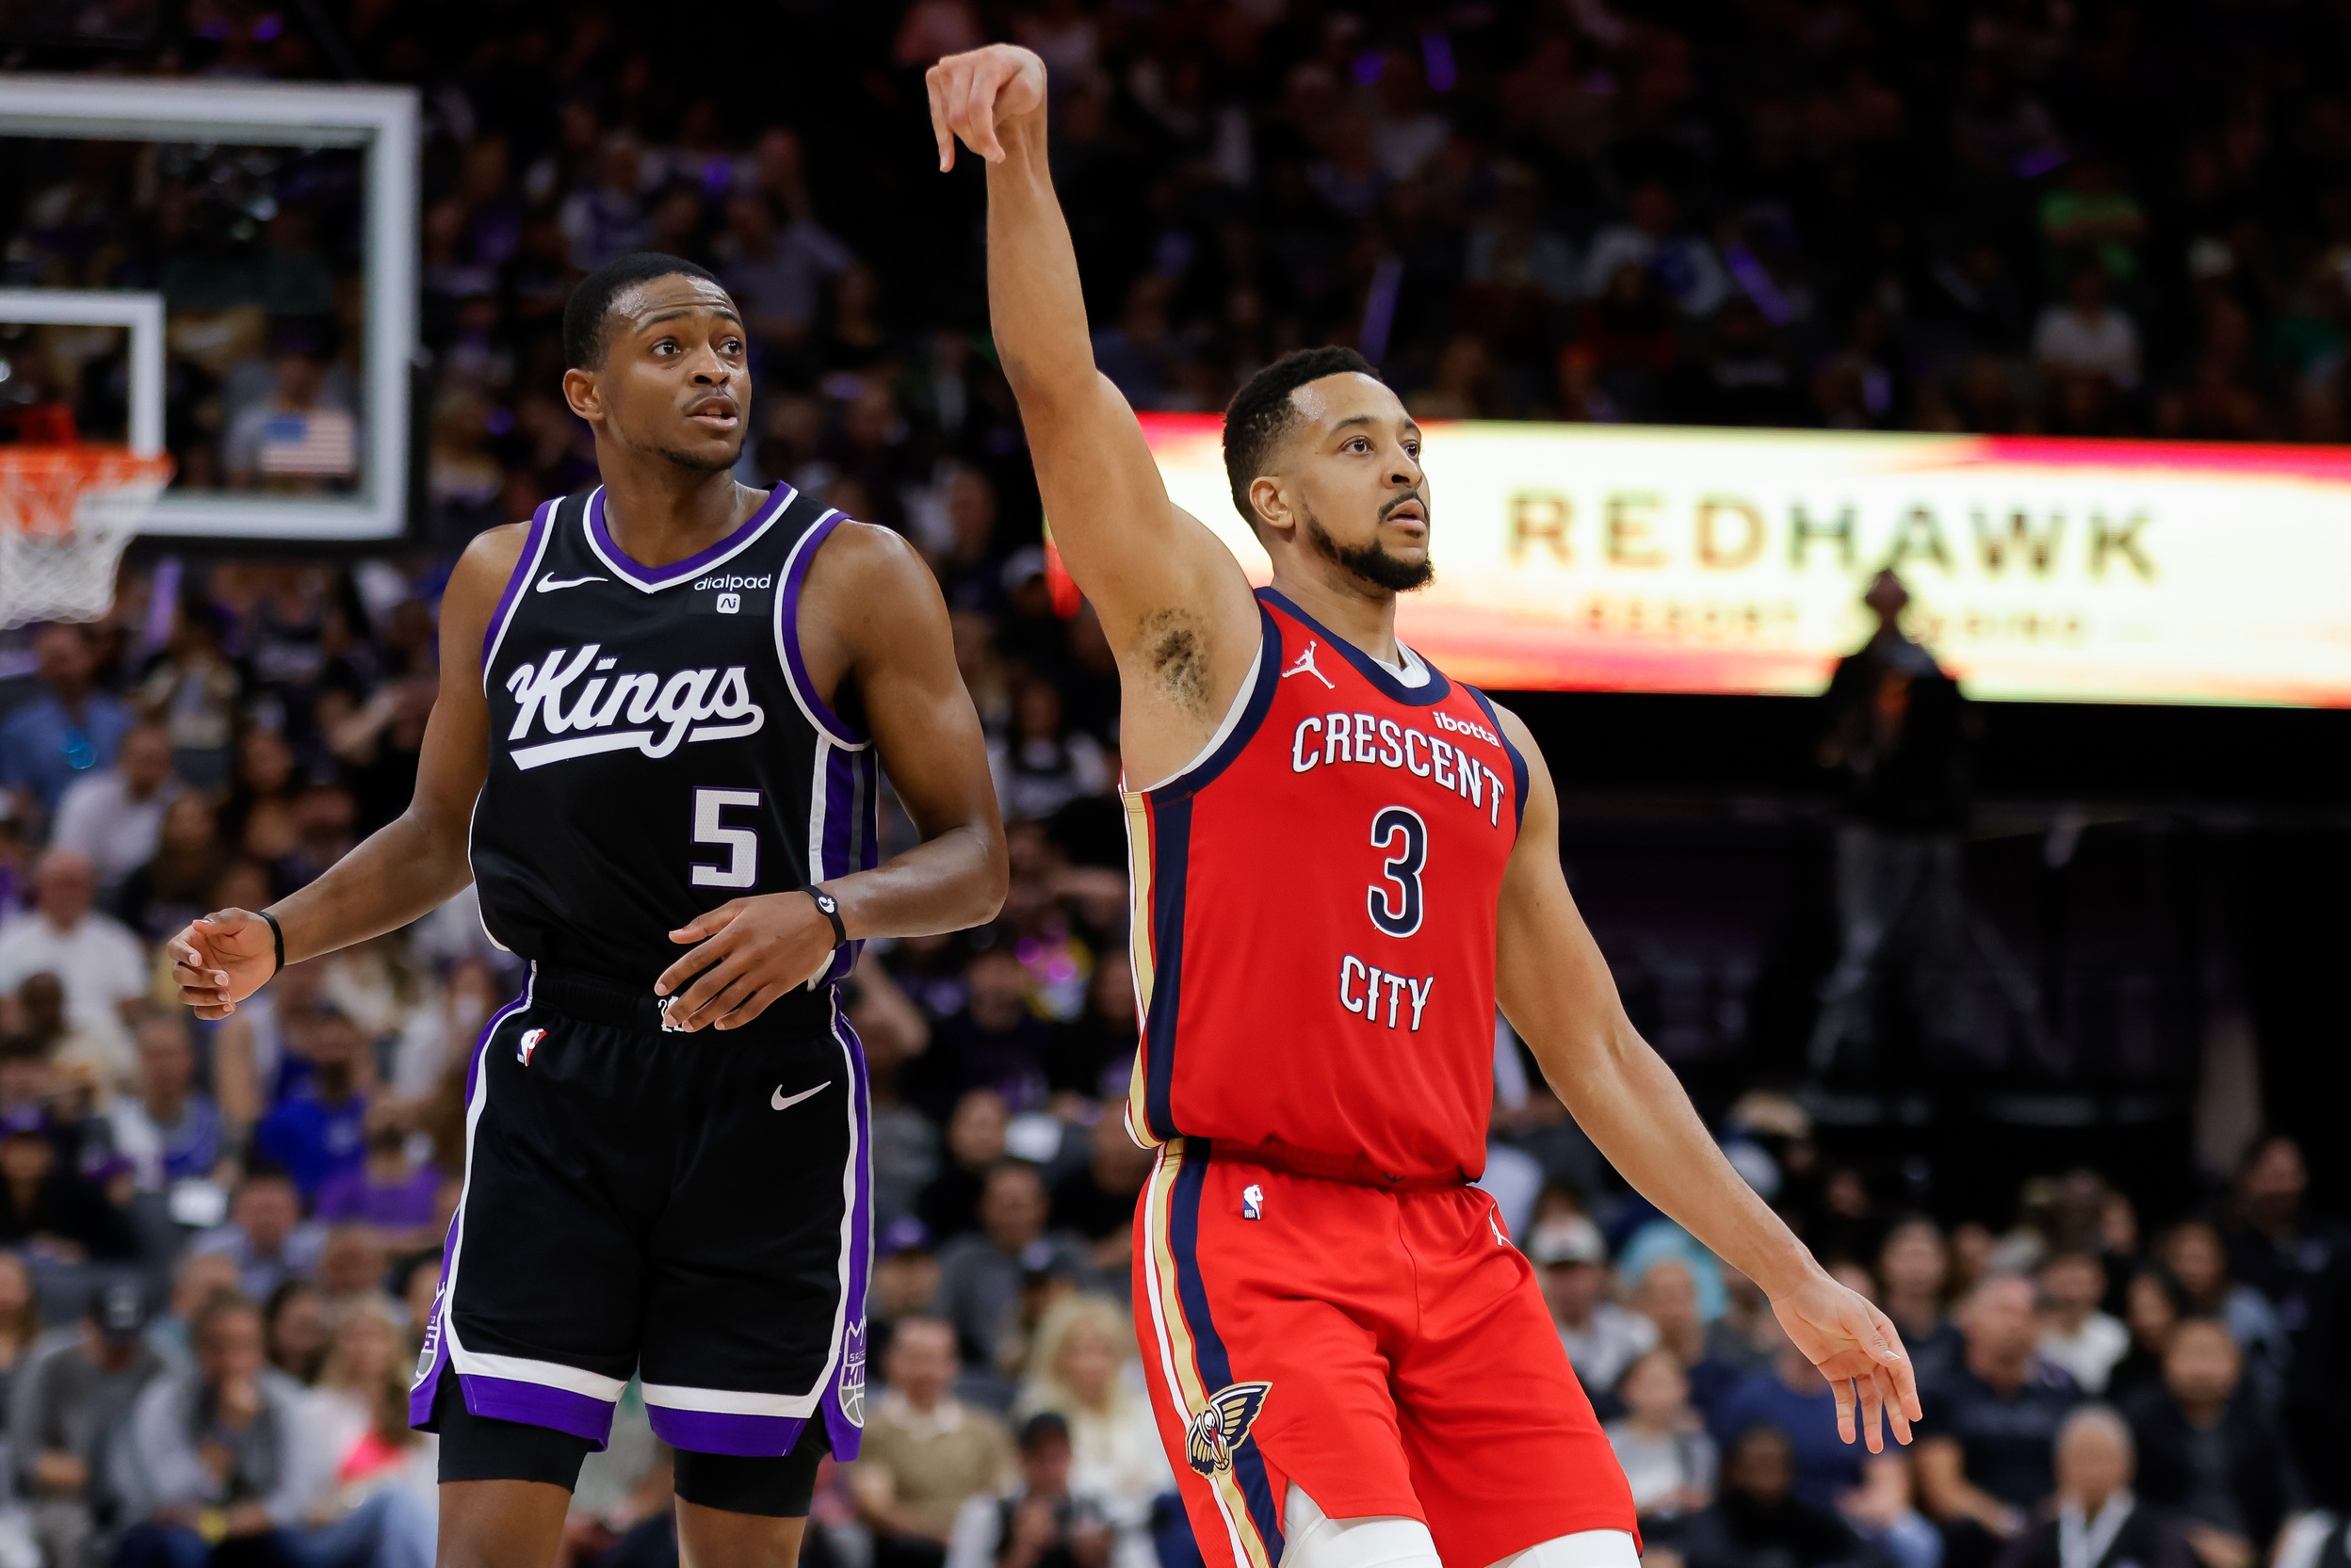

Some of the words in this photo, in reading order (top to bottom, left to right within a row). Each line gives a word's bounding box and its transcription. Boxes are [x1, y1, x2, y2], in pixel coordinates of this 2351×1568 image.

[694, 574, 771, 591] dialpad
[506, 644, 765, 771] Kings
[1432, 711, 1501, 748] ibotta
[1291, 713, 1505, 828] CRESCENT
[689, 786, 763, 890] 5
[1367, 805, 1429, 939] 3
[1339, 953, 1435, 1031] CITY
[1244, 1209, 1256, 1219] NBA
